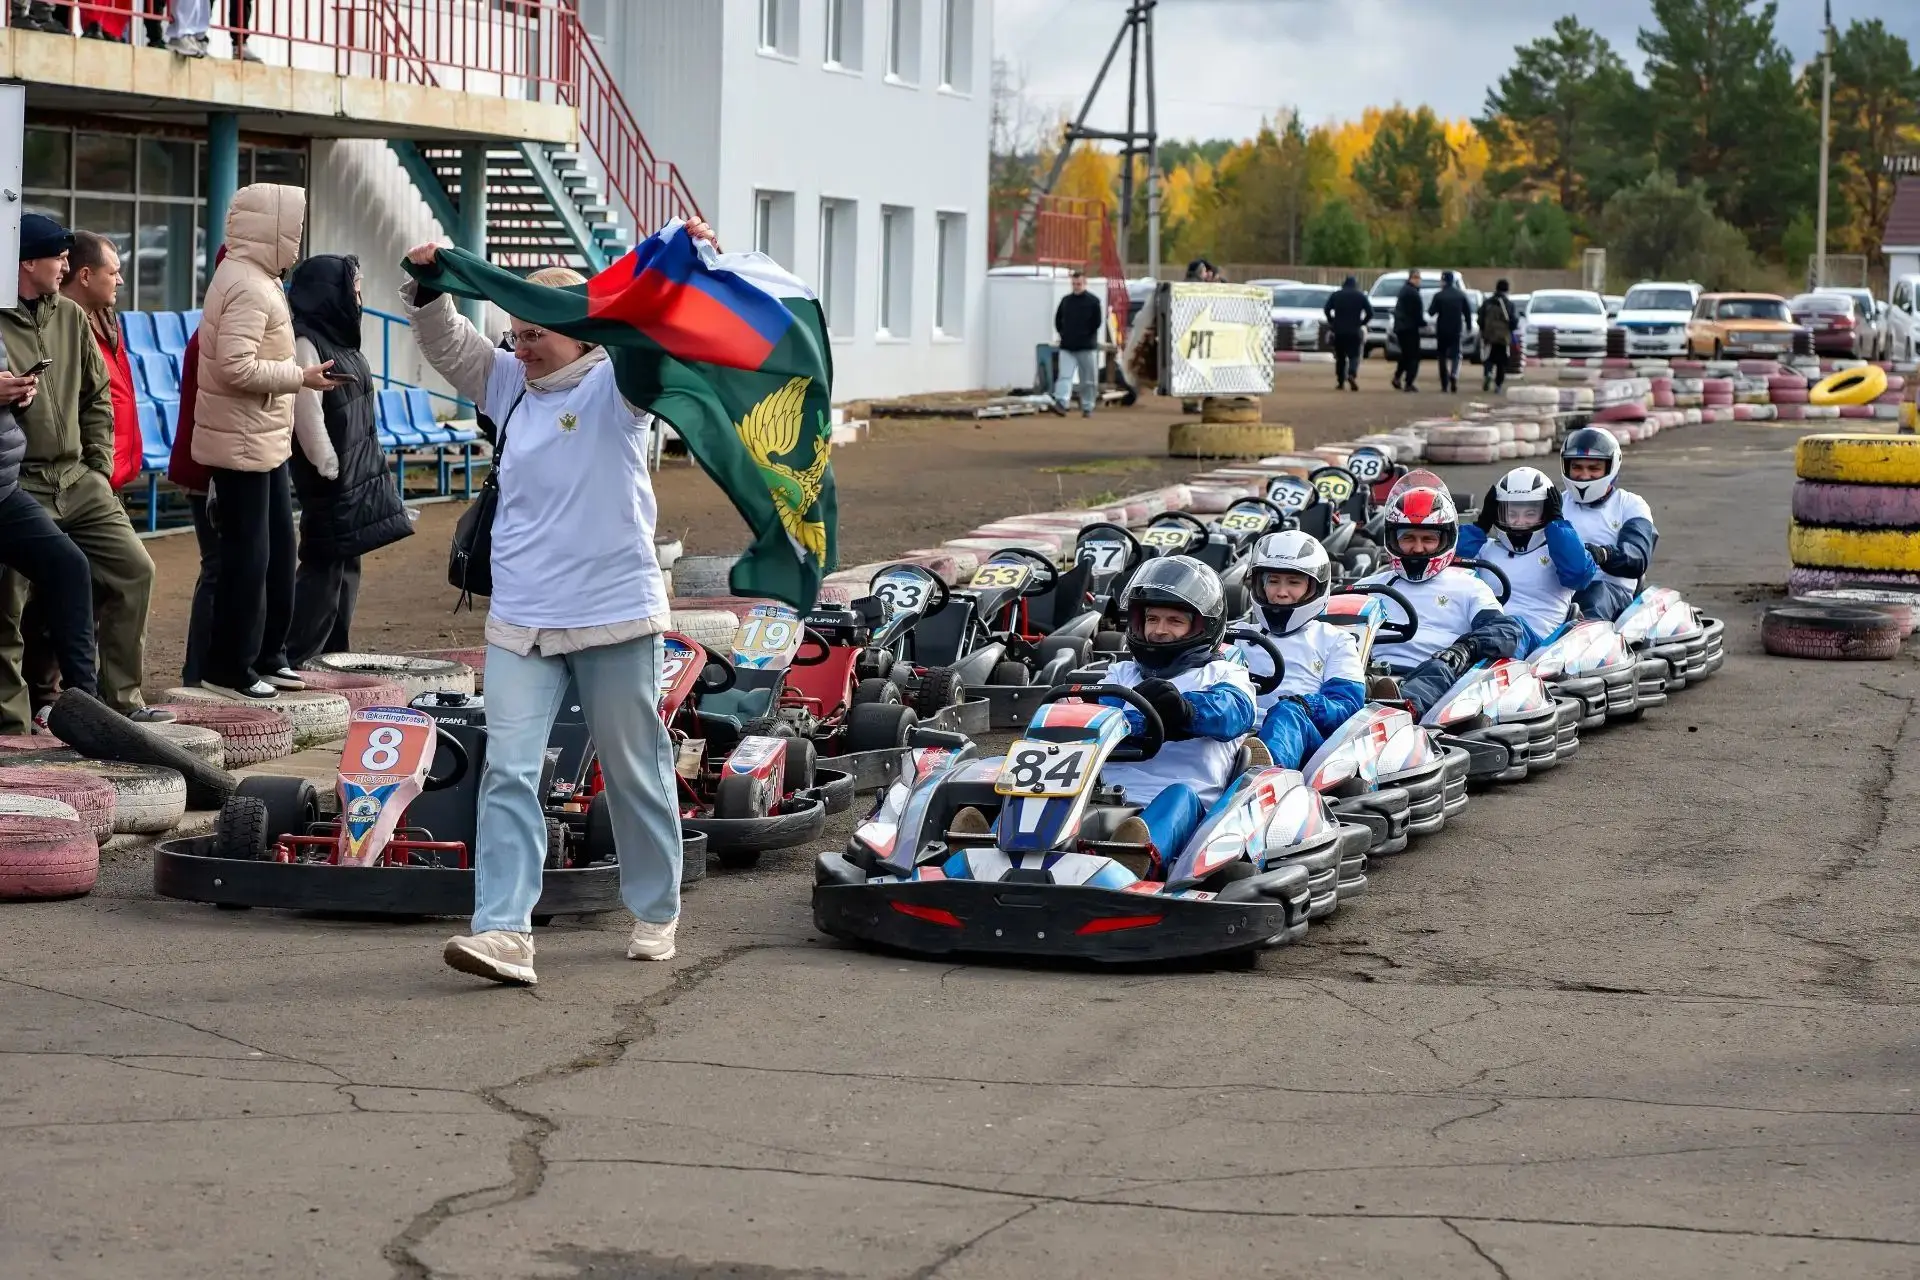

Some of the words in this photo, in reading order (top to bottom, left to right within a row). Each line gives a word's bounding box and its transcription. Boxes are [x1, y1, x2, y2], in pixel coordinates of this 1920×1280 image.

[1187, 331, 1213, 359] PIT
[1350, 459, 1378, 476] 68
[1271, 487, 1305, 506] 65
[1317, 481, 1347, 495] 60
[1226, 515, 1260, 529] 58
[1145, 532, 1184, 544] 59
[1078, 546, 1122, 568] 67
[974, 568, 1020, 586] 53
[874, 583, 923, 608] 63
[813, 616, 841, 624] LIFAN
[742, 618, 790, 650] 19
[365, 711, 426, 725] @kartingbratsk
[434, 716, 462, 725] LIFAN
[361, 726, 404, 771] 8
[1010, 749, 1085, 788] 84
